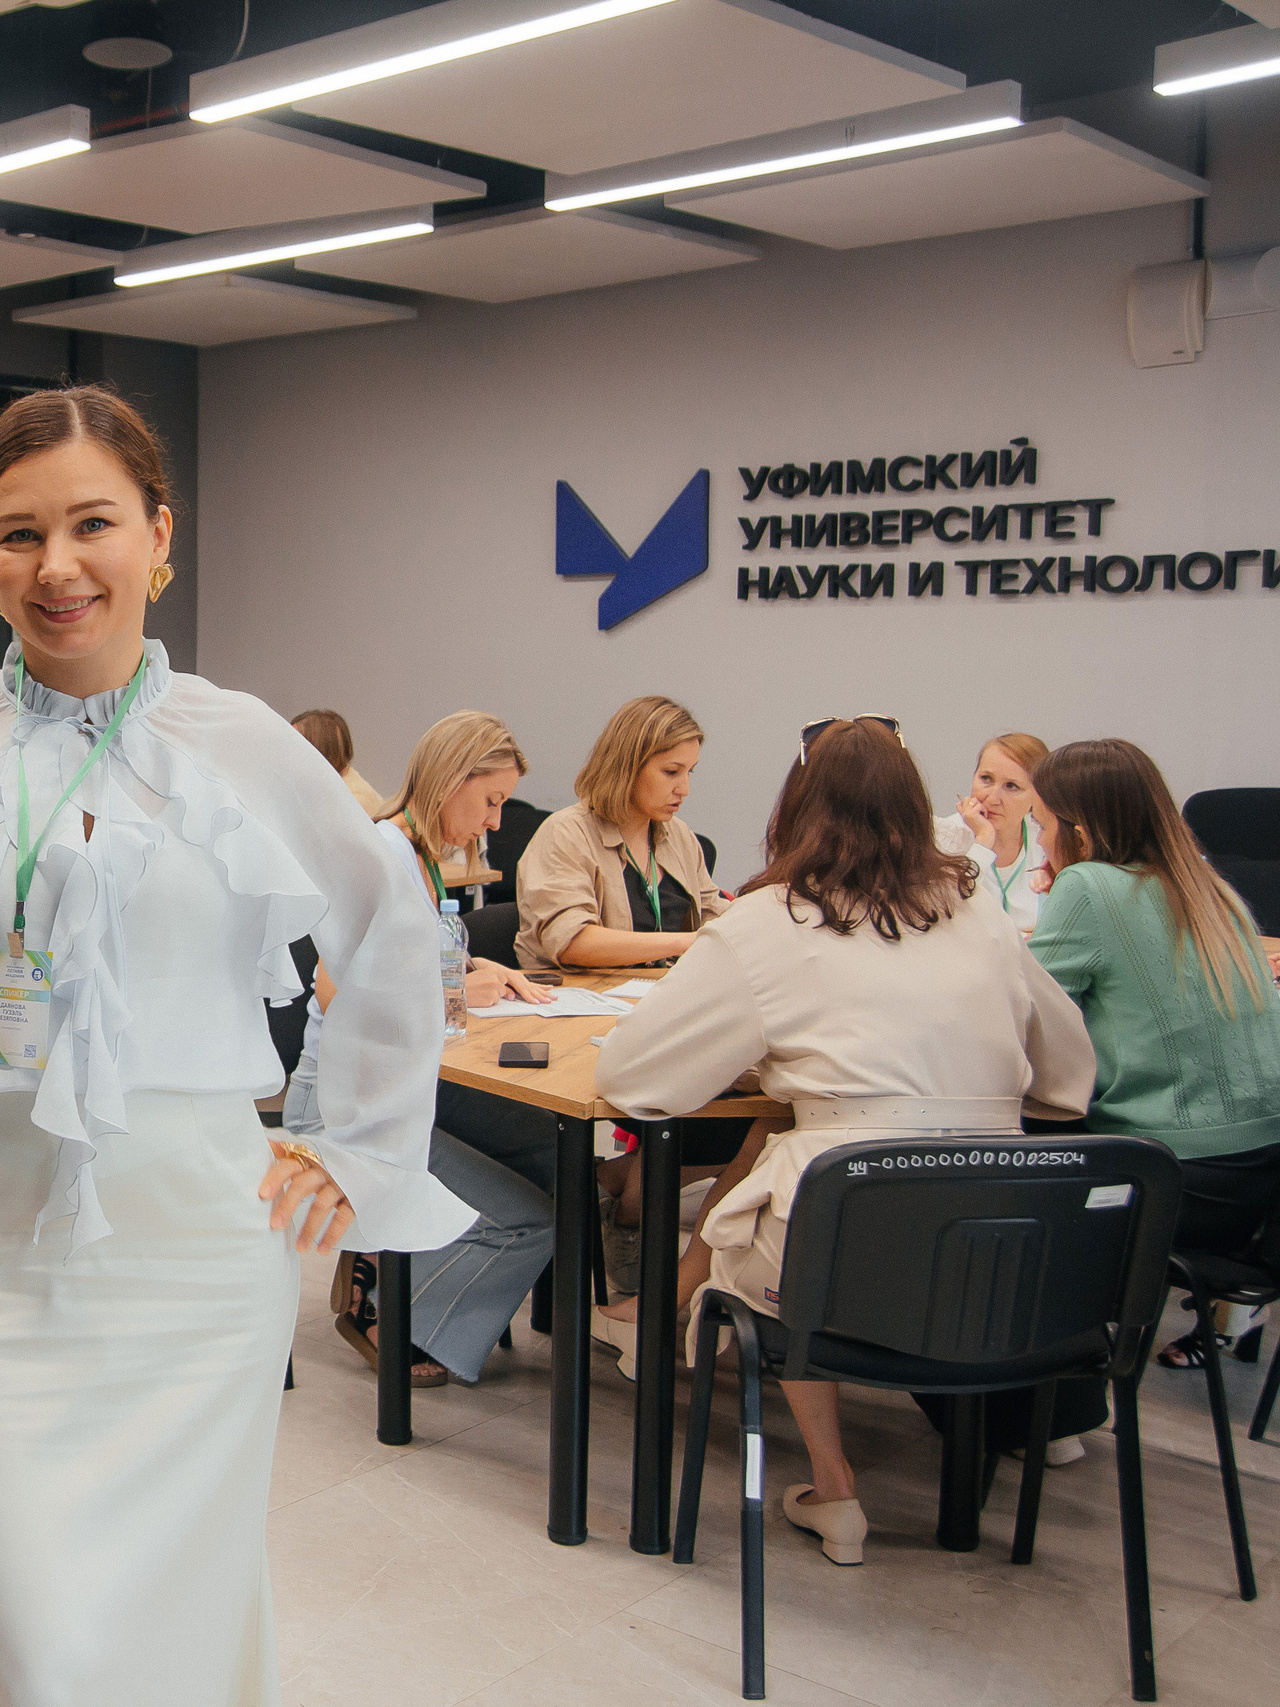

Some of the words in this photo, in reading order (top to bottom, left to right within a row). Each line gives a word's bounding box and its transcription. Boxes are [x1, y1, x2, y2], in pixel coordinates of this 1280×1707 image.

[738, 437, 1038, 502] УФИМСКИЙ
[738, 498, 1116, 551] УНИВЕРСИТЕТ
[738, 563, 895, 601] НАУКИ
[908, 561, 945, 598] И
[0, 988, 29, 998] СПИКЕР
